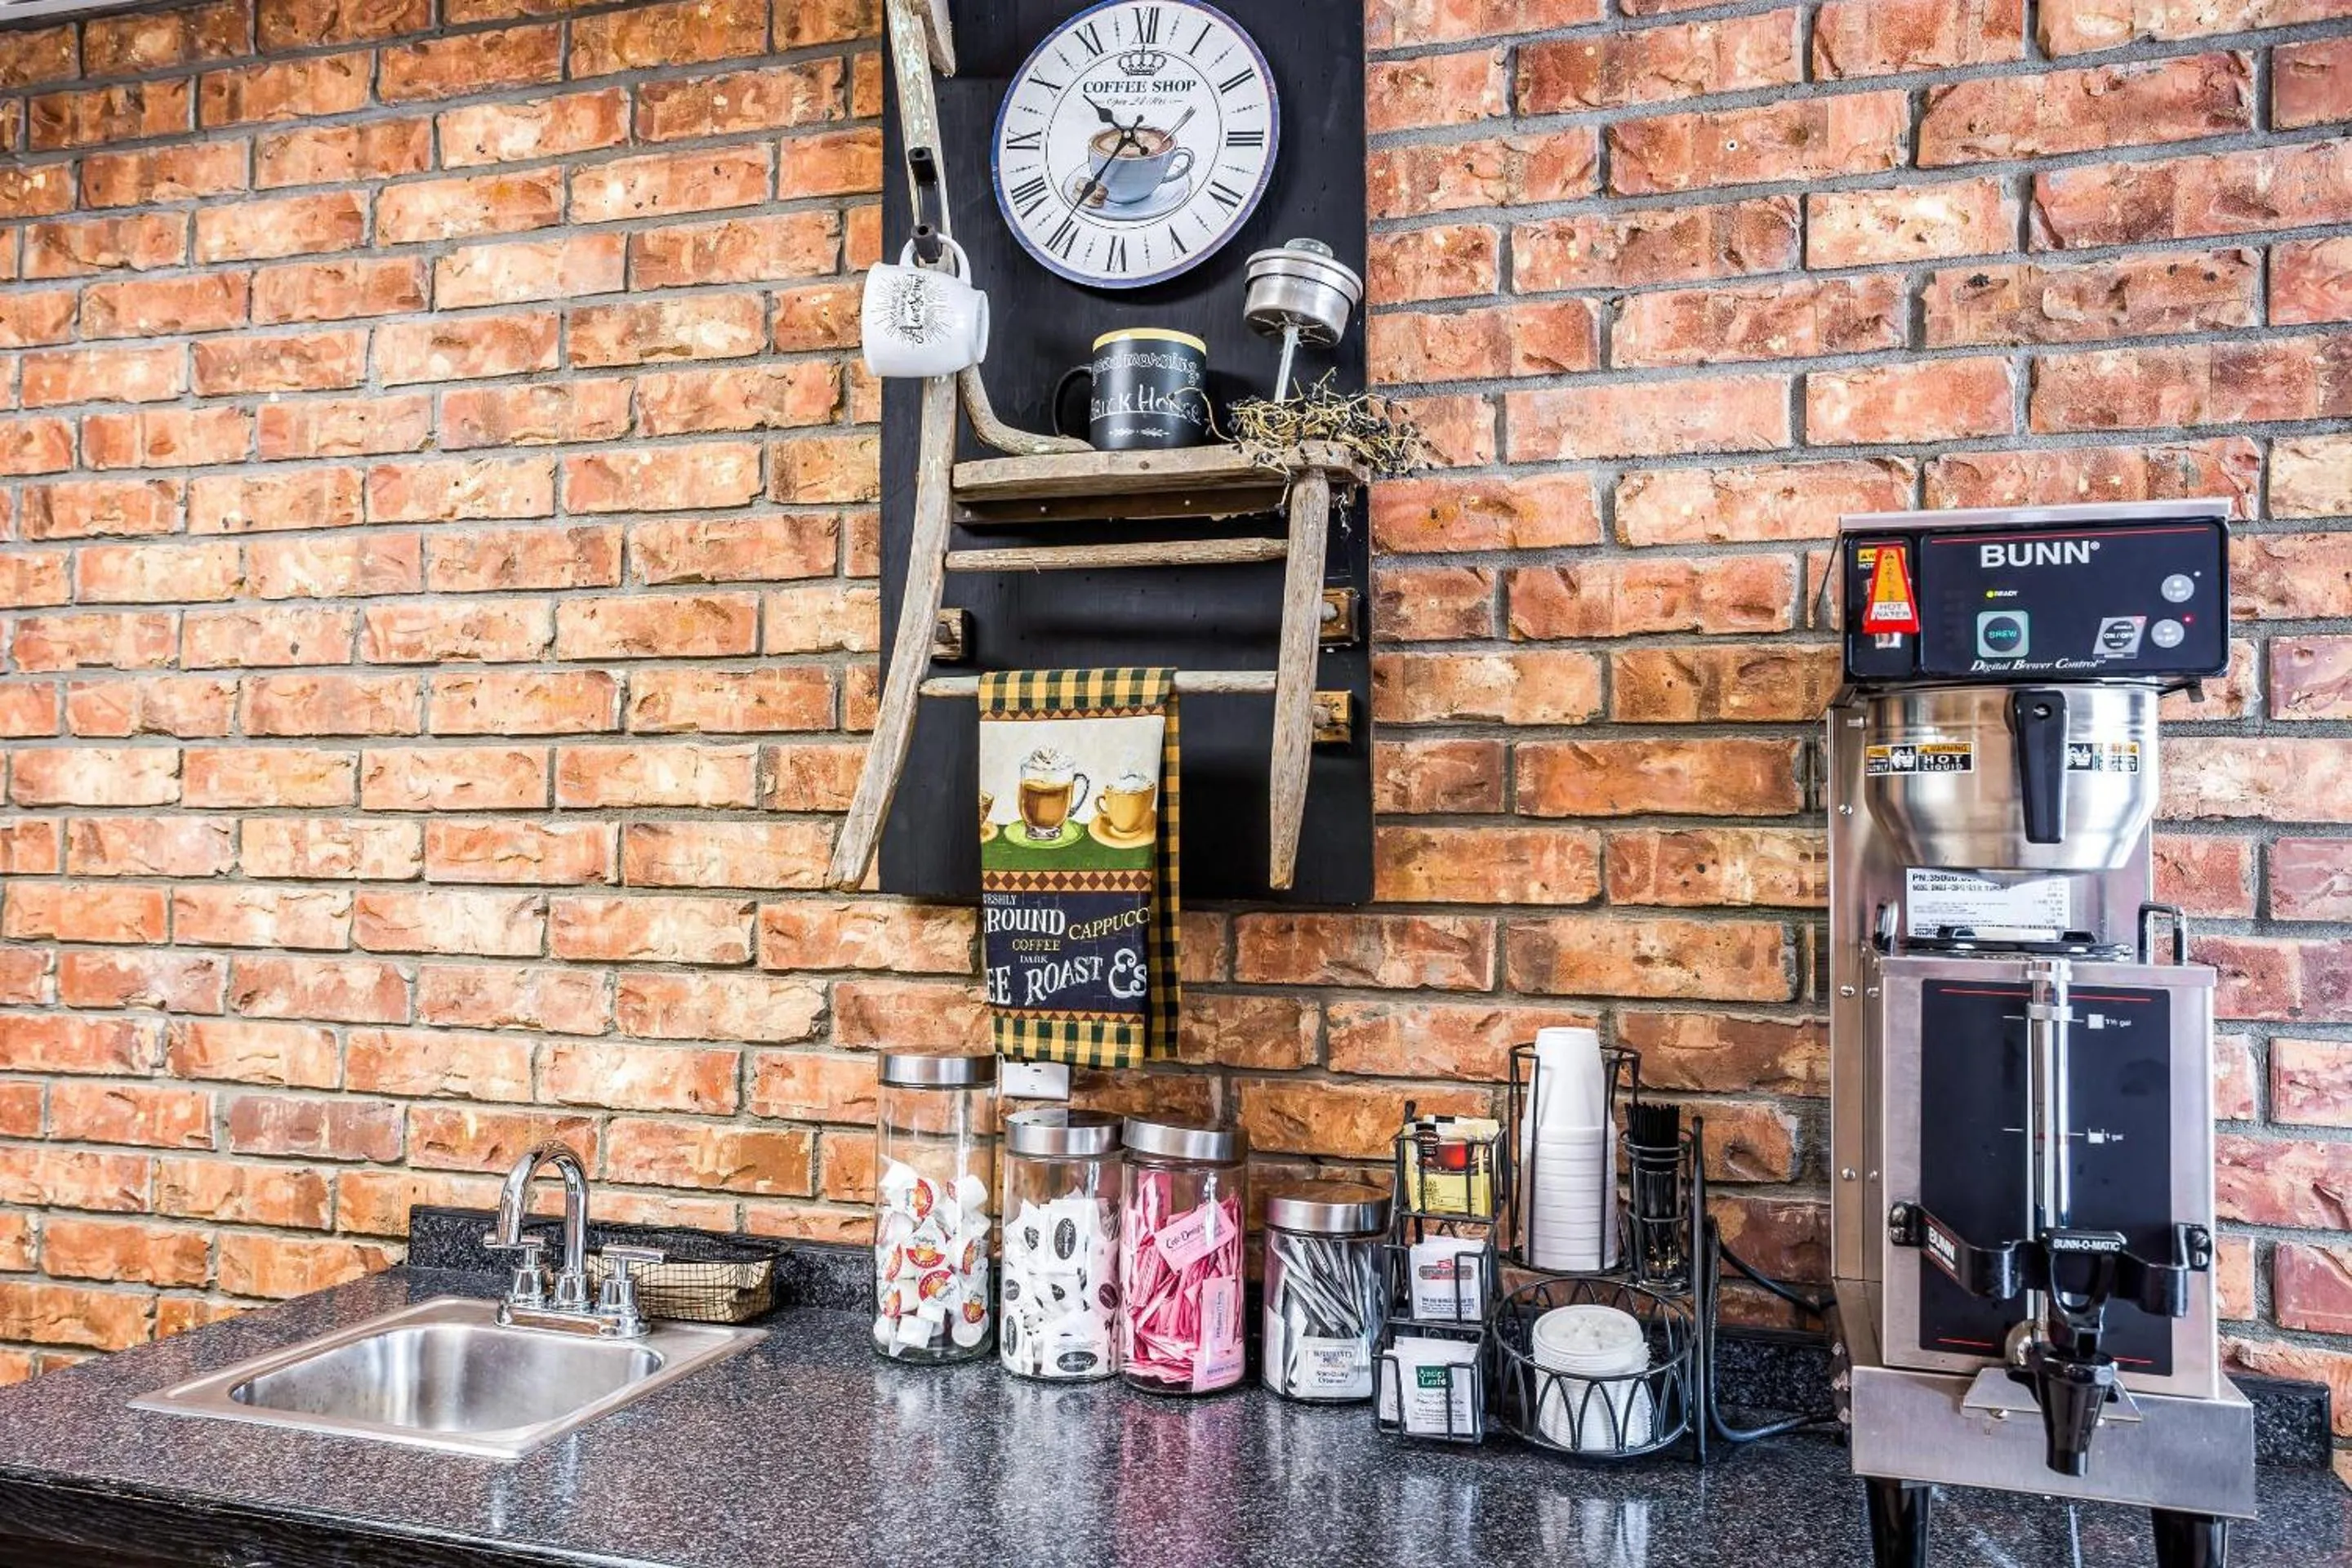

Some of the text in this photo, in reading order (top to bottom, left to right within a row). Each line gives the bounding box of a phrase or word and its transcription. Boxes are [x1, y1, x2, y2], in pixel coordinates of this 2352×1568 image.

[1083, 80, 1196, 93] COFFEE SHOP
[1980, 541, 2089, 568] BUNN
[1969, 660, 2011, 673] Digital
[2012, 659, 2053, 670] Brewer
[1925, 755, 1962, 764] HOT
[984, 908, 1065, 935] ROUND
[1013, 939, 1060, 951] COFFEE
[1020, 955, 1048, 964] DARK
[1024, 956, 1103, 1006] ROAST
[1928, 1226, 1955, 1262] BUNN
[2053, 1238, 2121, 1251] BUNN-O-MATIC
